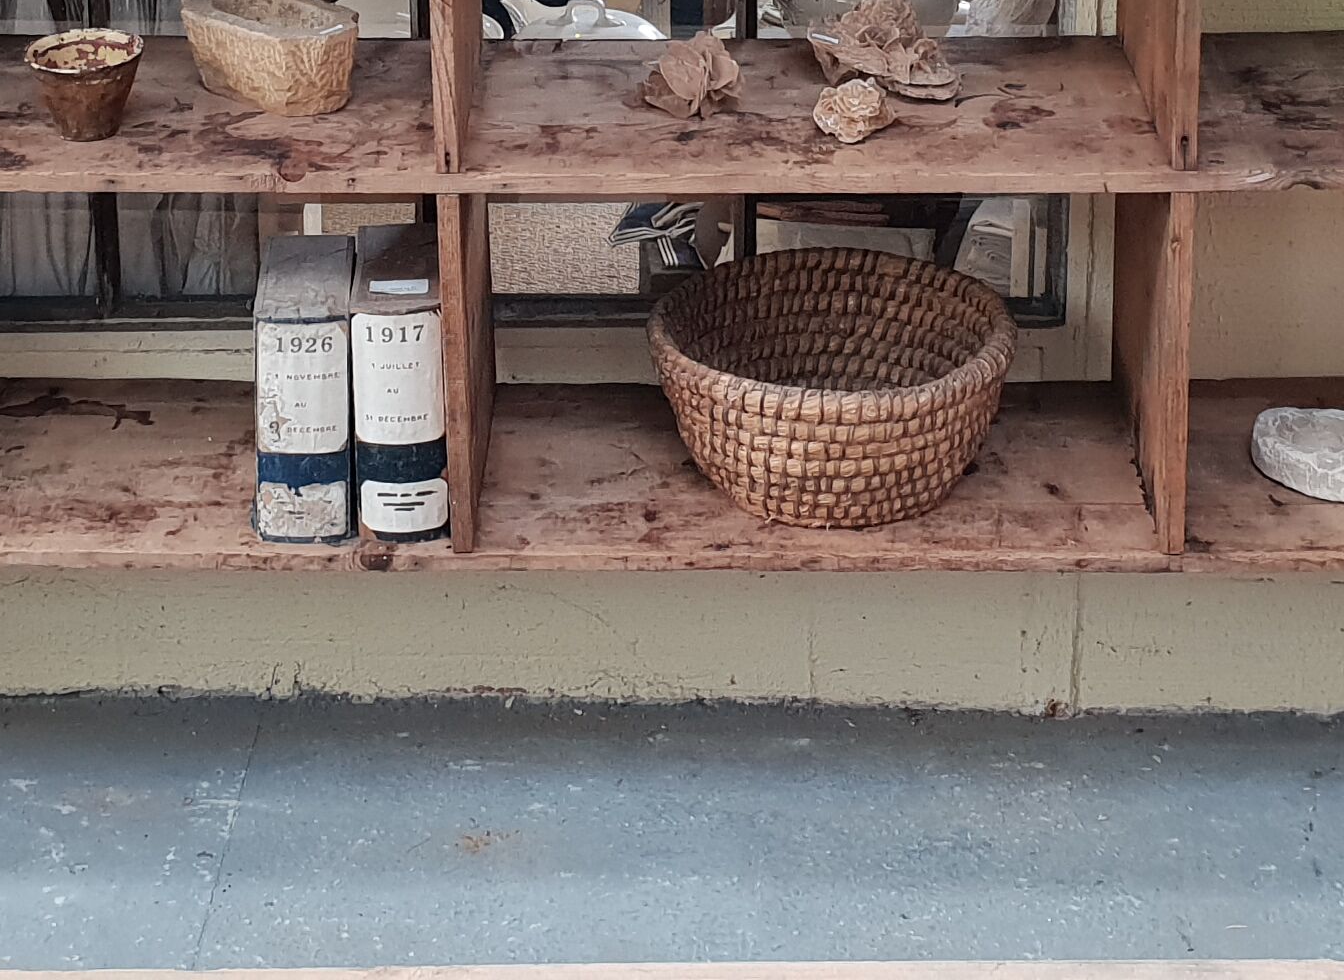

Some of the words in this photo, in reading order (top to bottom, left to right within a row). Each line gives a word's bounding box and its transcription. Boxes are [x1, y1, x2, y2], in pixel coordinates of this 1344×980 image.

[365, 324, 425, 343] 1917
[275, 336, 333, 353] 1926
[380, 361, 420, 370] JUILLET
[286, 371, 341, 381] NOVEMBRE
